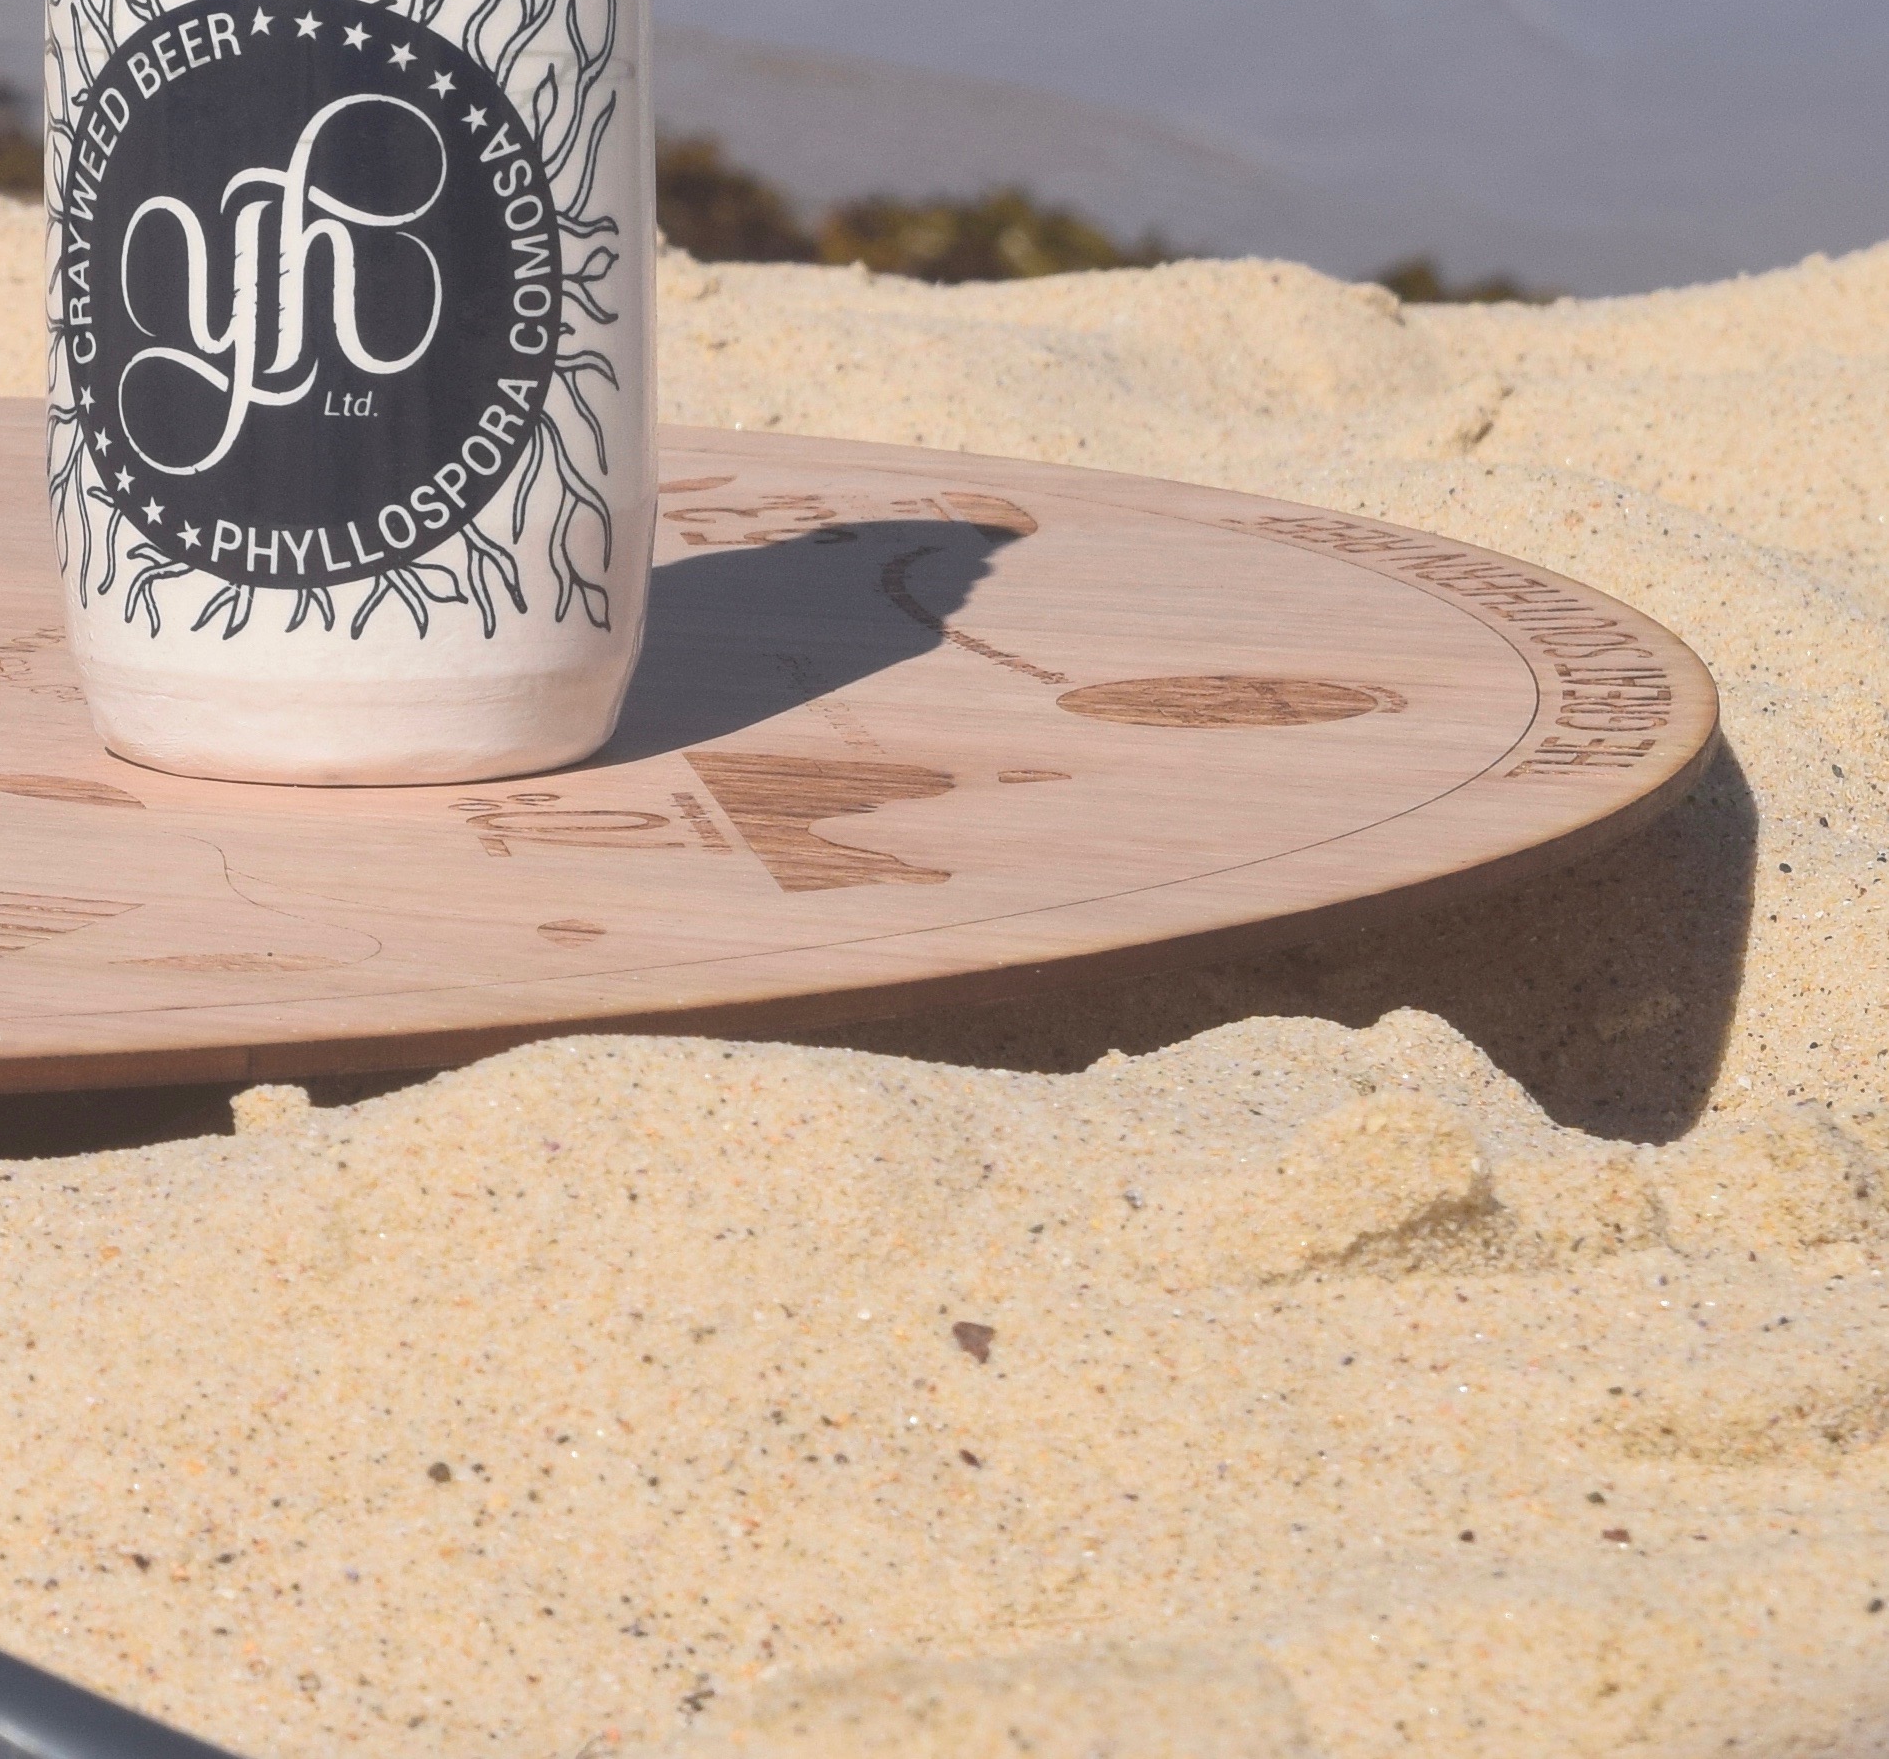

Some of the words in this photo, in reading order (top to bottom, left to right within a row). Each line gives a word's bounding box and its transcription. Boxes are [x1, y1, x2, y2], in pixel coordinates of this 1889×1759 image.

[67, 88, 130, 365] CRAYWEED
[127, 10, 242, 98] BEER
[210, 379, 540, 575] PHYLLOSPORA
[479, 121, 551, 356] COMOSA
[323, 390, 380, 419] Ltd.
[1376, 553, 1654, 660] SOUTHERN
[1552, 662, 1674, 733] GREAT
[1503, 737, 1657, 779] THE
